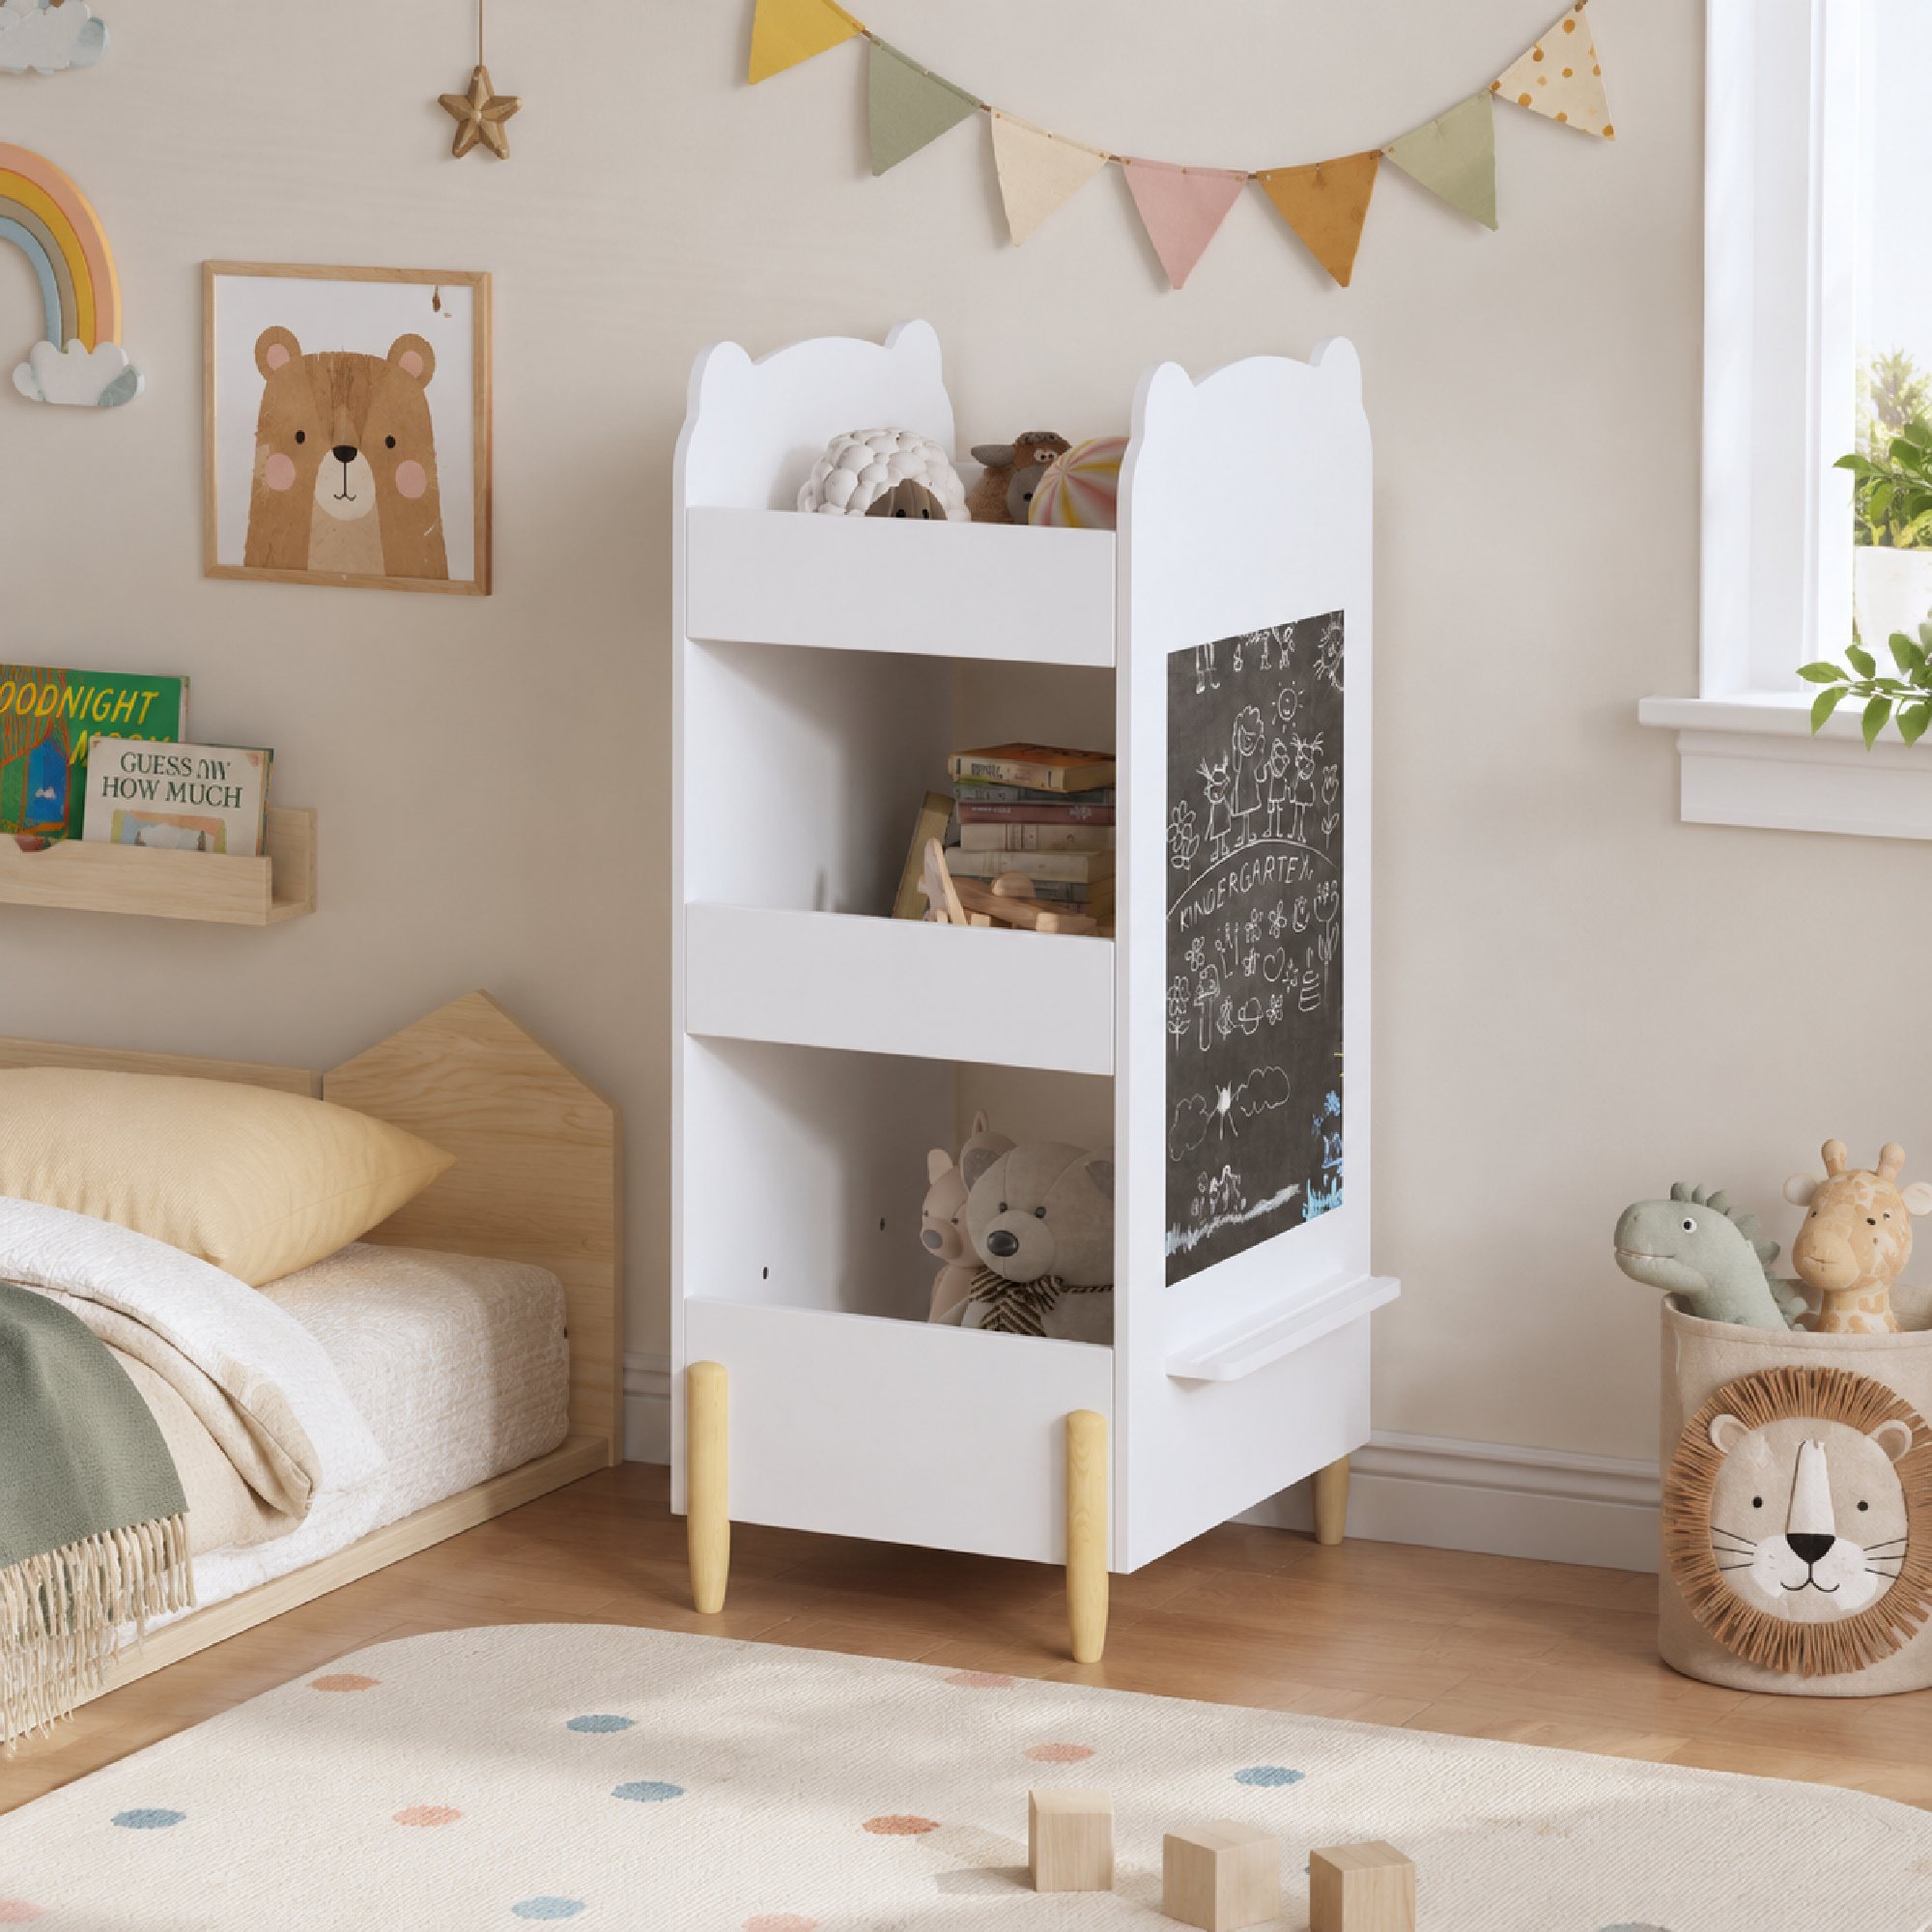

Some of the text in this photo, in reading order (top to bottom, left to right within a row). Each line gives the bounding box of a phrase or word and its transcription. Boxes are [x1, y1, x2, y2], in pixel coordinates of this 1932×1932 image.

[120, 752, 192, 777] GUESS
[101, 777, 242, 809] HOW MUCH
